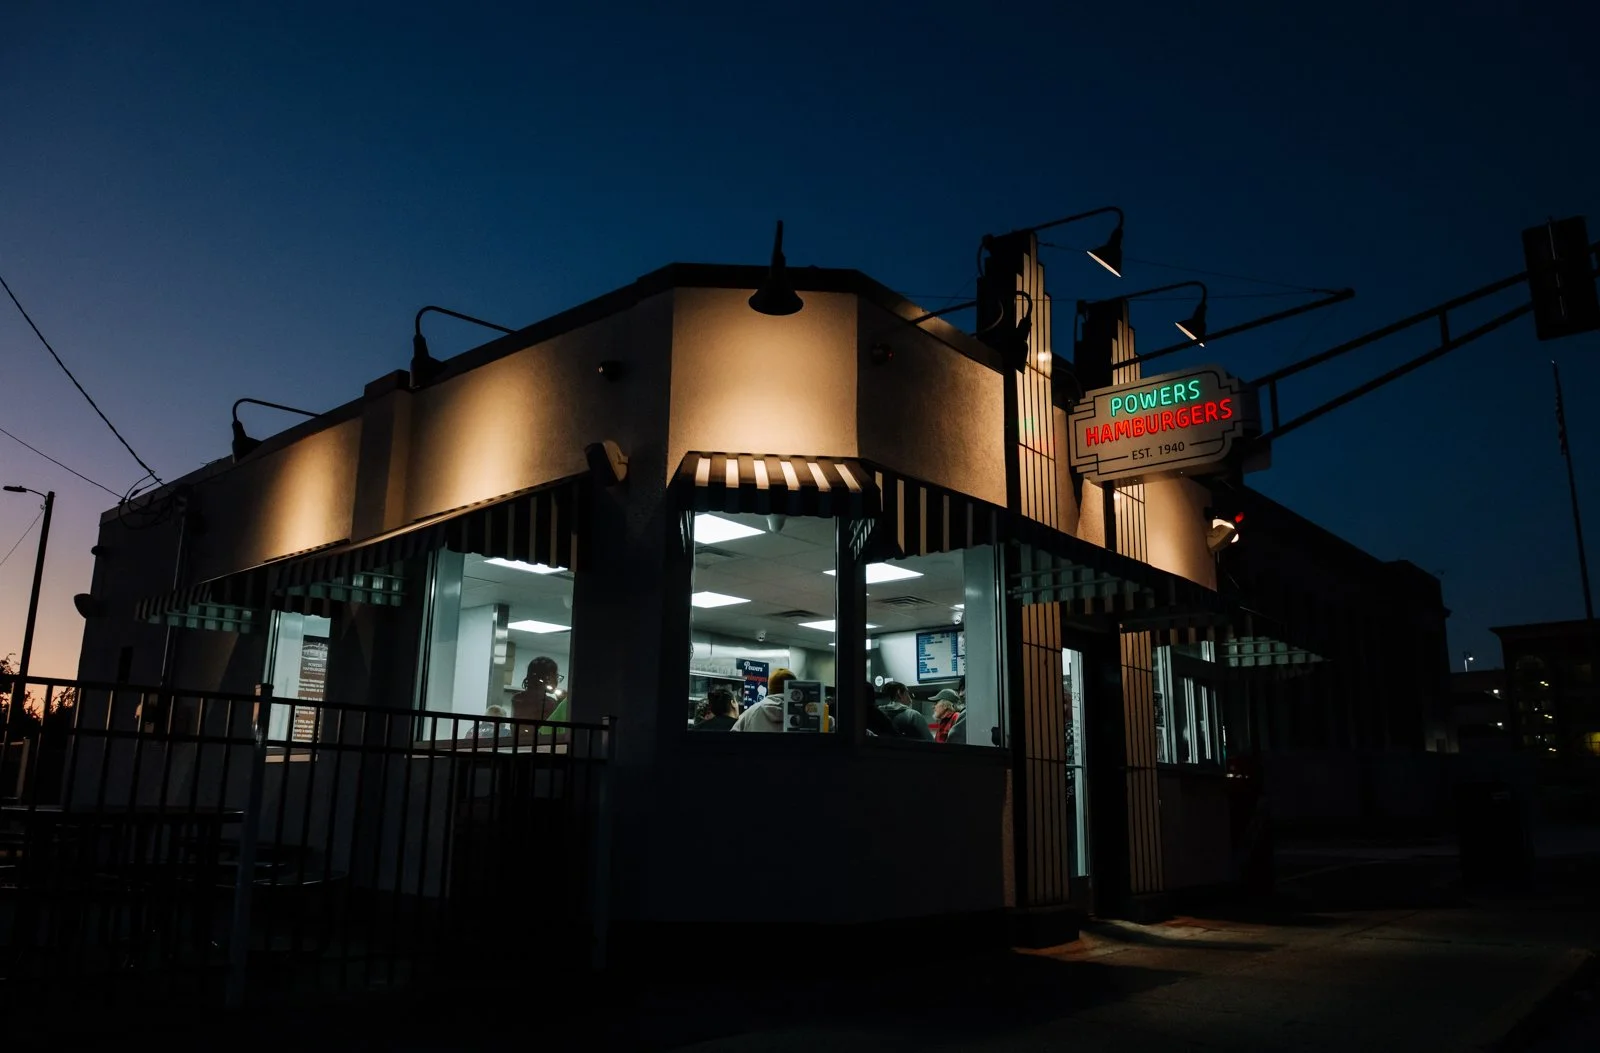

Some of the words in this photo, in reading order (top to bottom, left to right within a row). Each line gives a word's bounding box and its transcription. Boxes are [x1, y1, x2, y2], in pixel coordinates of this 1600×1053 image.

[1110, 379, 1201, 417] POWERS
[1085, 398, 1233, 447] HAMBURGERS
[1132, 447, 1153, 461] EST.
[1158, 441, 1185, 456] 1940
